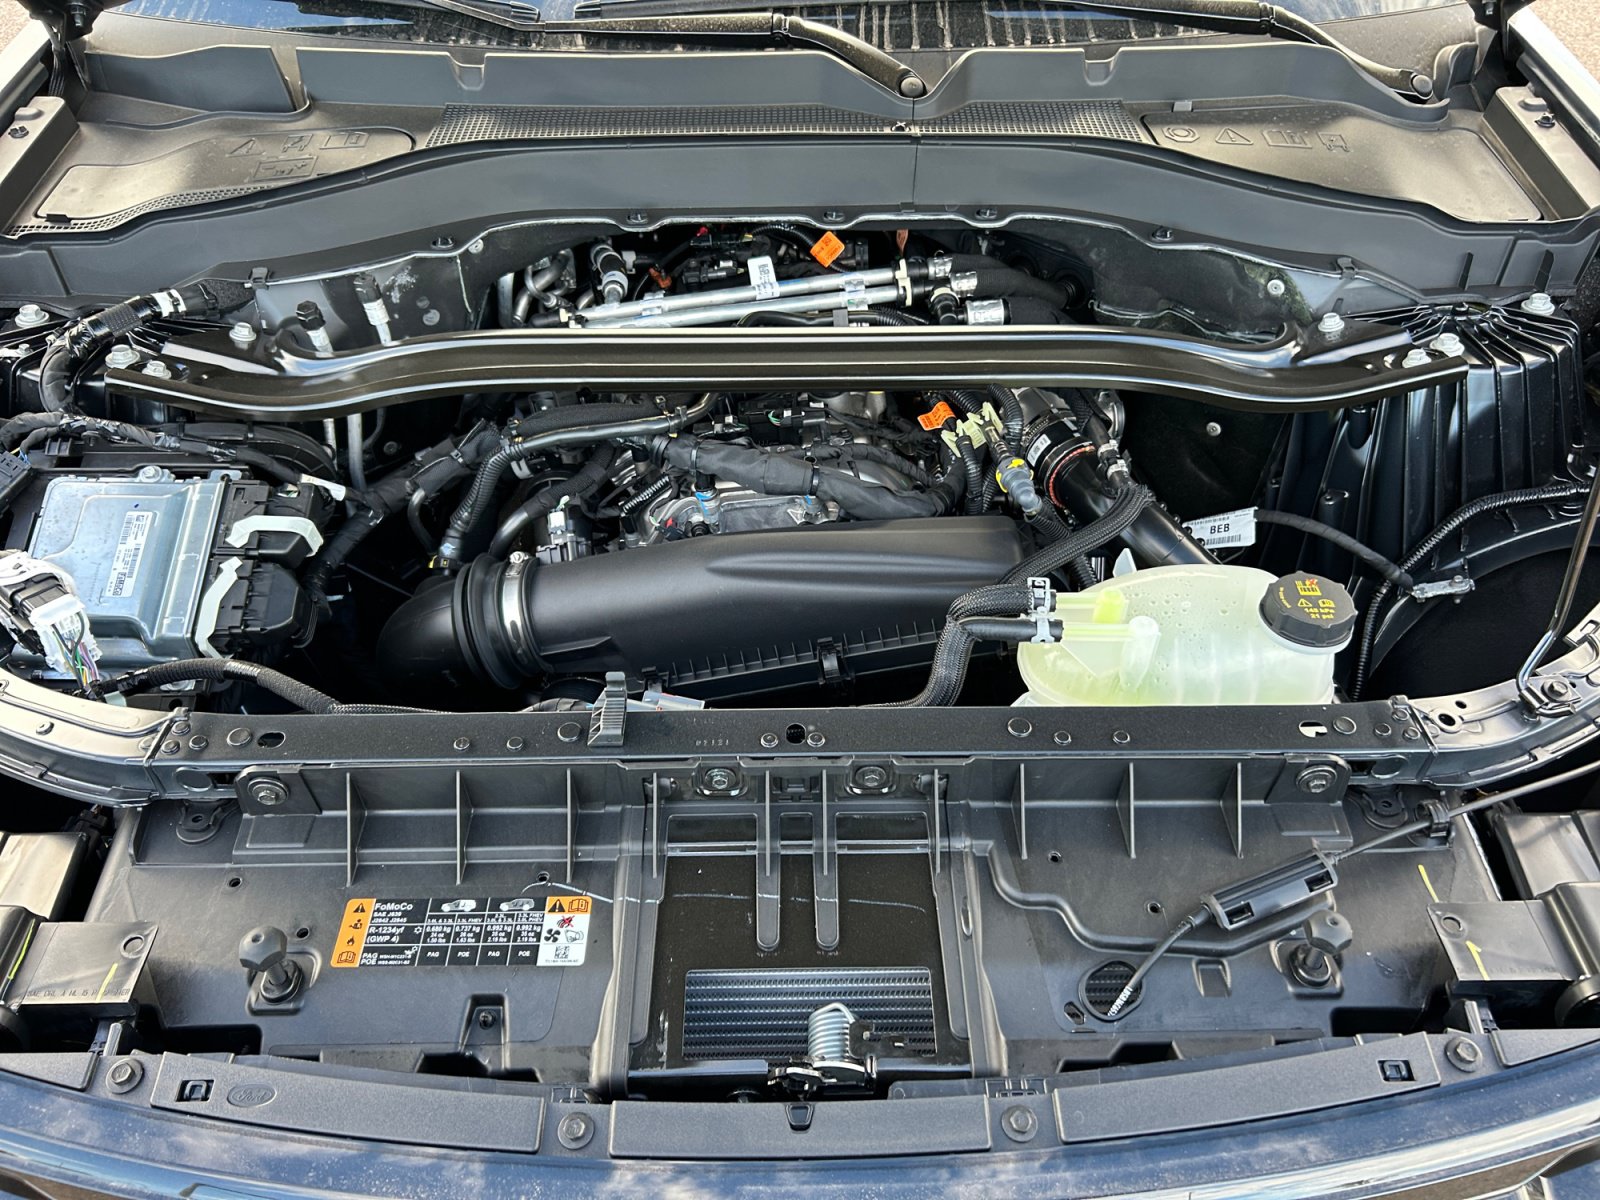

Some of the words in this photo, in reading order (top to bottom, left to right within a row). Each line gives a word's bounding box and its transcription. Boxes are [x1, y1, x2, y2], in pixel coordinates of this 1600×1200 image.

[1209, 523, 1230, 535] BEB
[374, 902, 413, 910] FoMoCo
[368, 927, 405, 935] R-1234yf
[472, 925, 481, 933] kg
[366, 936, 390, 944] (GWP
[232, 1088, 272, 1103] Ford
